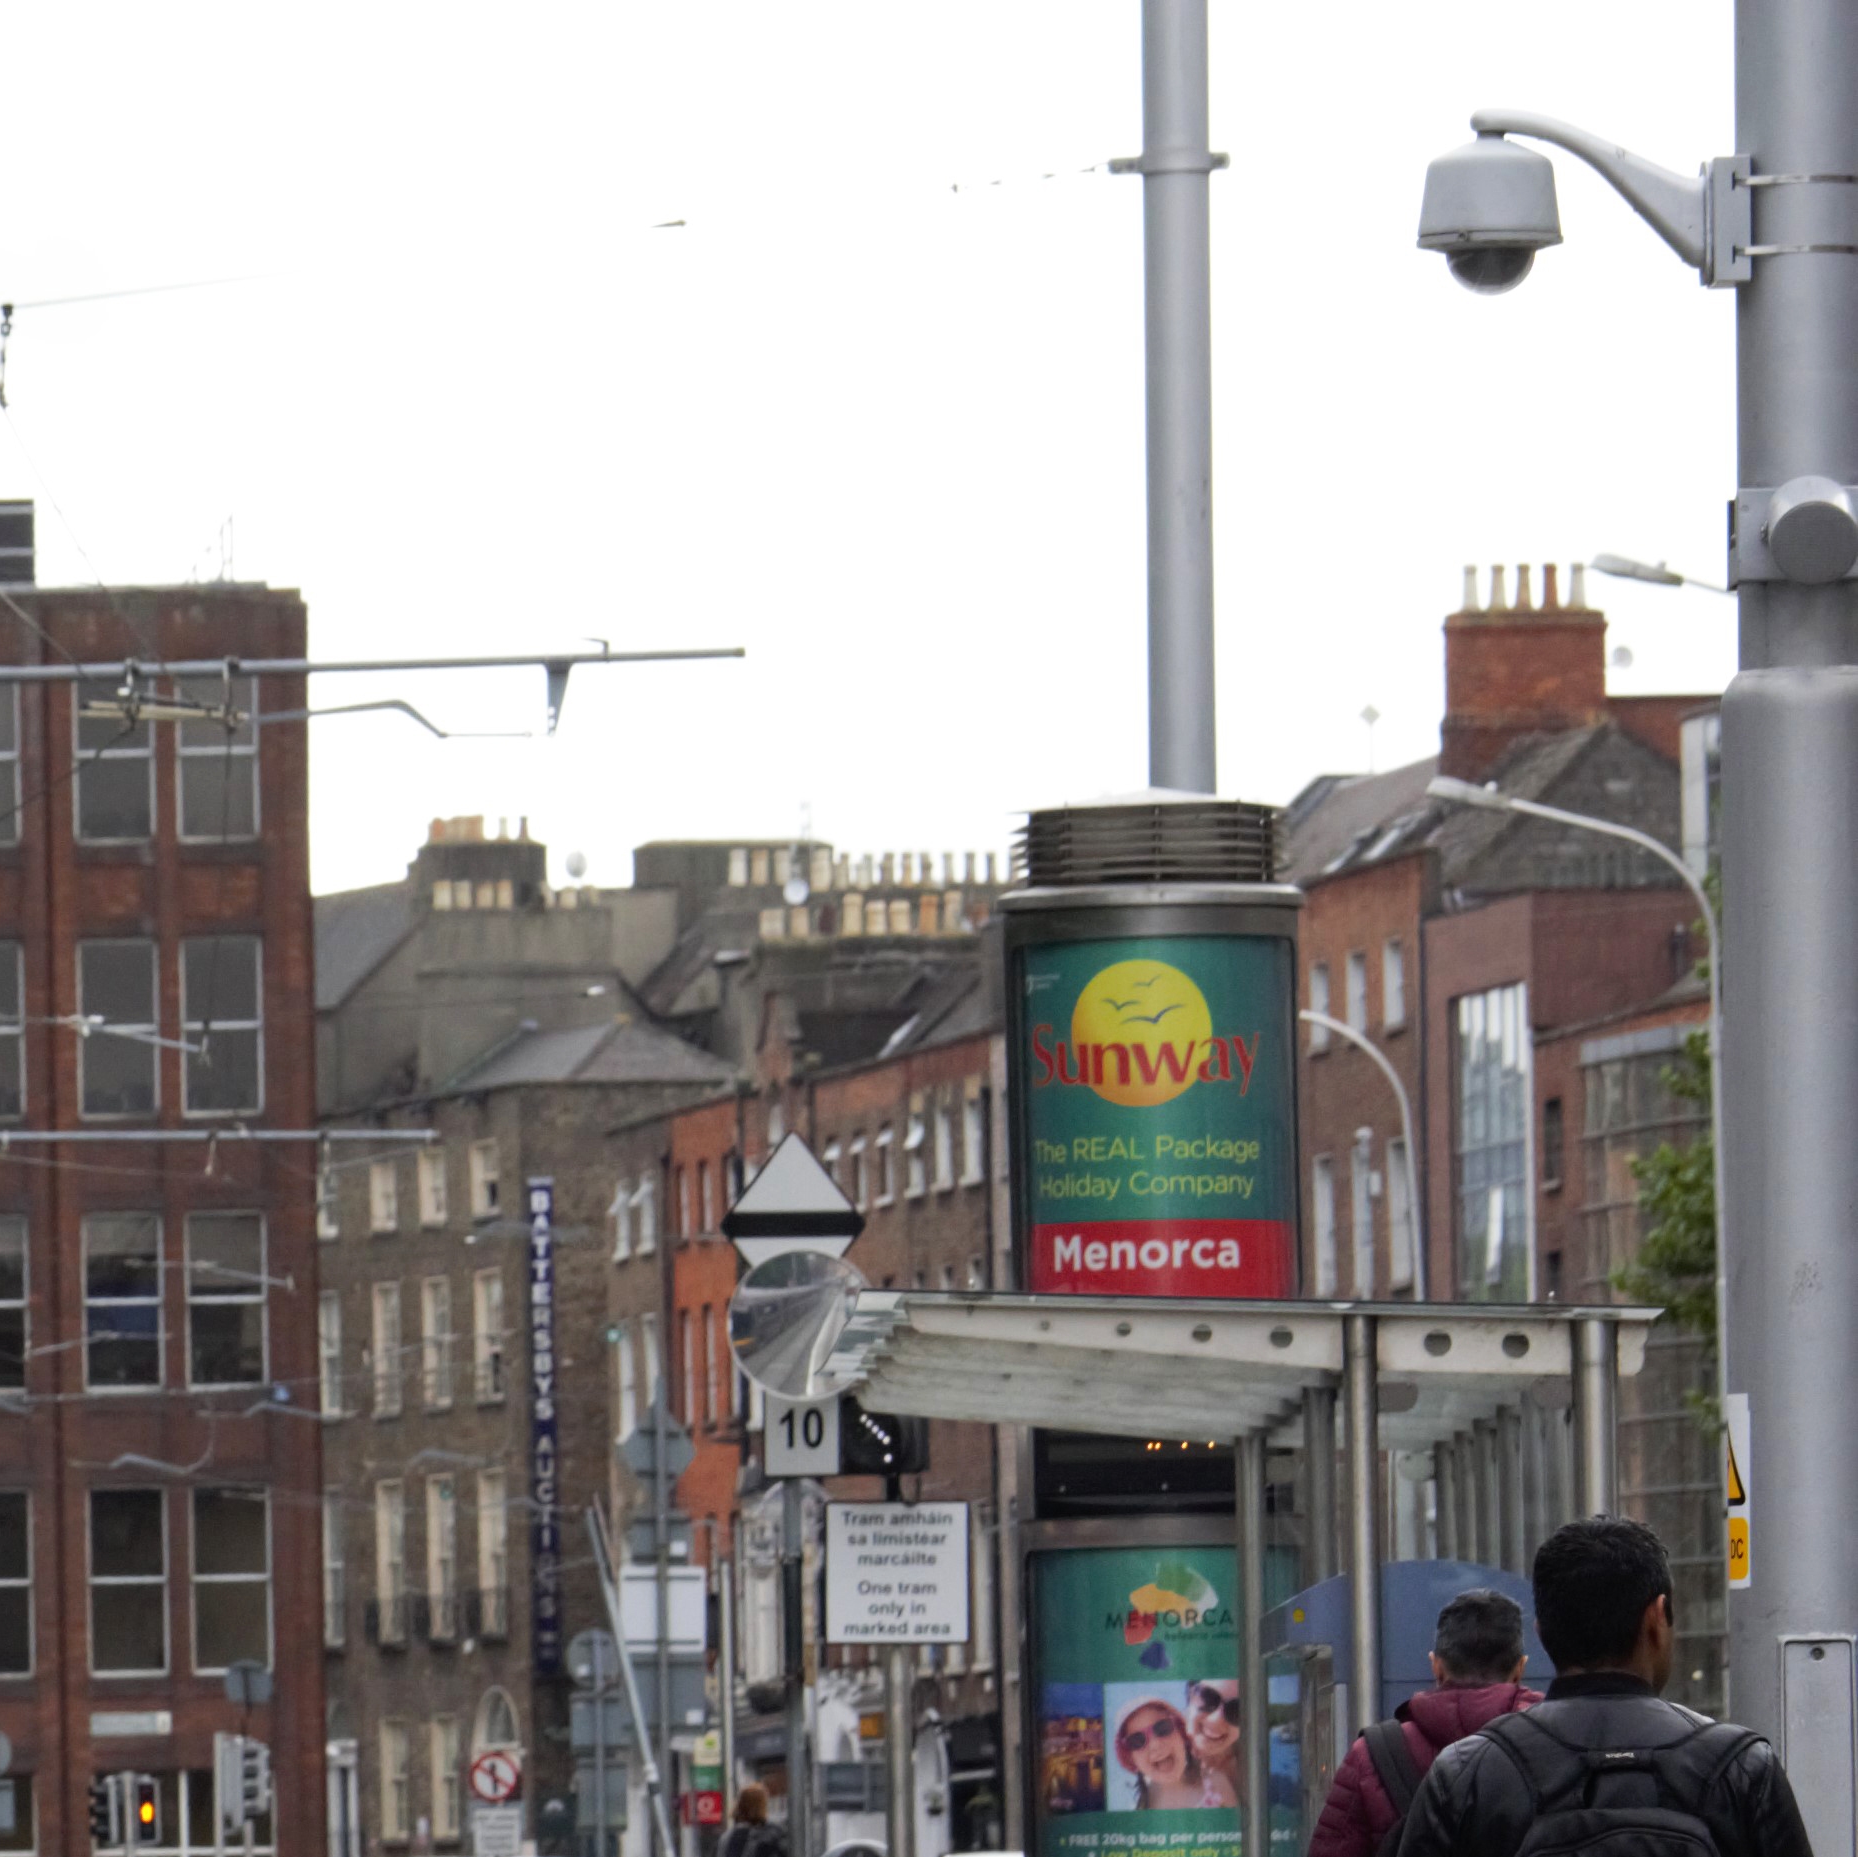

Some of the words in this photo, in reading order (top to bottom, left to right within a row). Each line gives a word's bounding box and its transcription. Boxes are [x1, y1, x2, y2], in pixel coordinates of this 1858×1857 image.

[1032, 1024, 1260, 1096] Sunway
[1036, 1139, 1067, 1163] The
[1073, 1136, 1145, 1162] REAL
[1154, 1134, 1260, 1164] Package
[1039, 1173, 1121, 1201] Holiday
[1129, 1170, 1254, 1199] Company
[1054, 1235, 1240, 1273] Menorca
[779, 1407, 824, 1448] 10
[841, 1511, 885, 1526] Tram
[889, 1510, 953, 1526] amháin
[847, 1533, 868, 1545] sa
[857, 1580, 892, 1595] One
[897, 1581, 937, 1595] tram
[868, 1600, 905, 1618] only
[911, 1600, 926, 1615] in
[844, 1621, 908, 1635] marked
[913, 1623, 951, 1635] area
[1105, 1609, 1234, 1631] MENORCA
[1102, 1832, 1135, 1847] 20kg
[1139, 1831, 1166, 1846] bag
[1170, 1833, 1193, 1846] per
